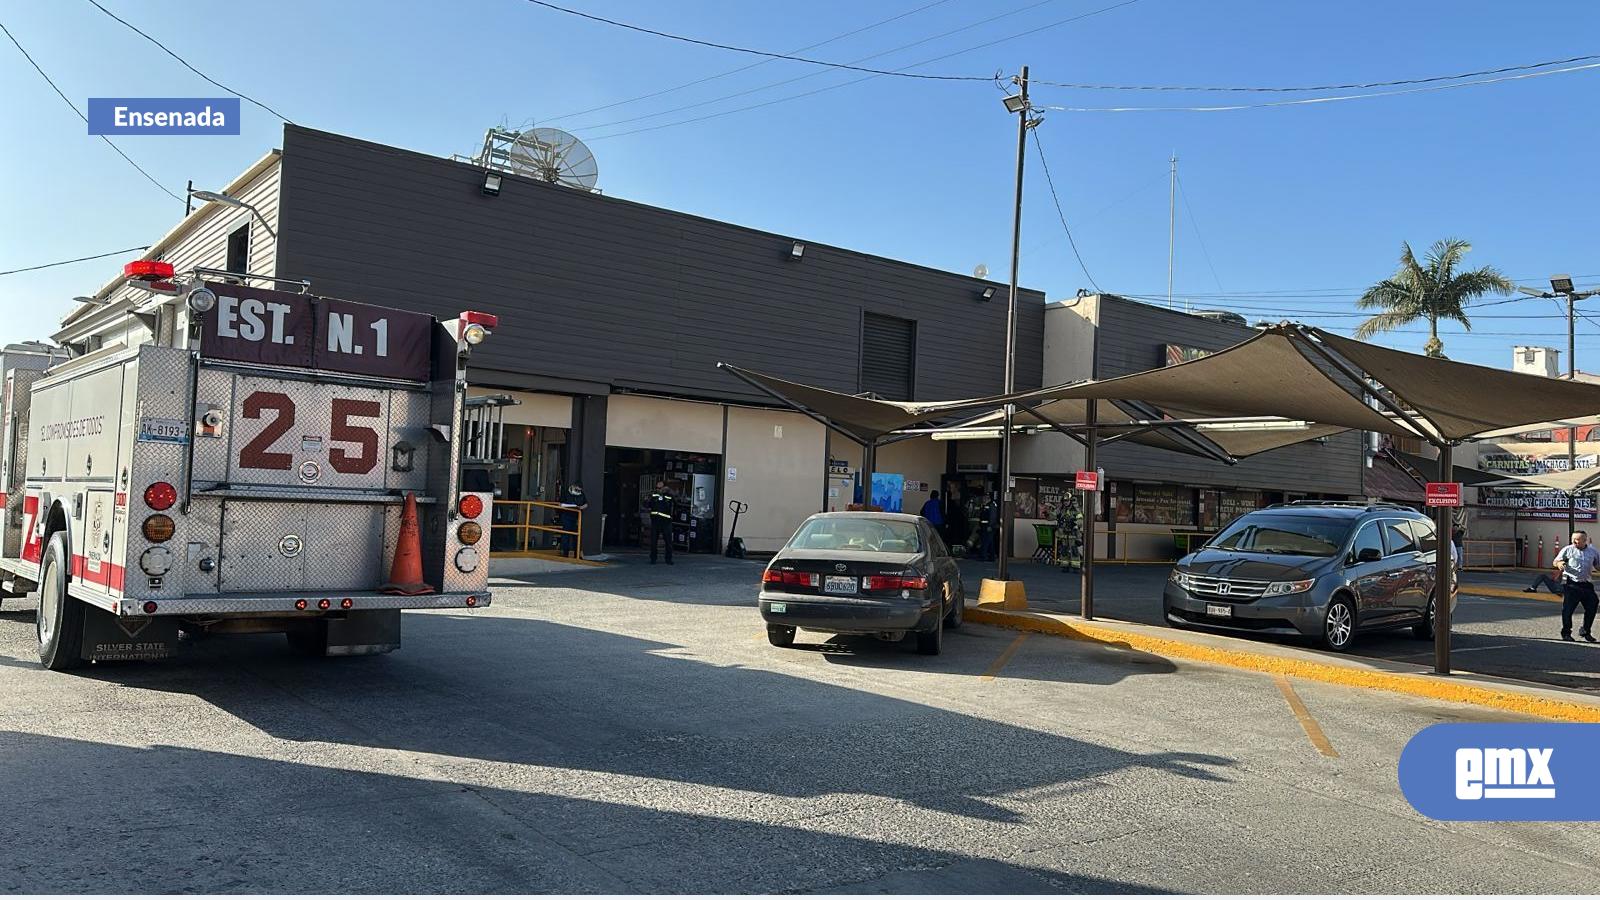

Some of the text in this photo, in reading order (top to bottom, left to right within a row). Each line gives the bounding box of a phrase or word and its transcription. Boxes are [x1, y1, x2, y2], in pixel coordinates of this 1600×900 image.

[217, 295, 388, 357] EST. N. 1
[1486, 459, 1529, 469] CARNITAS
[1536, 460, 1567, 469] MACHACA
[96, 642, 164, 652] SILVER STATE
